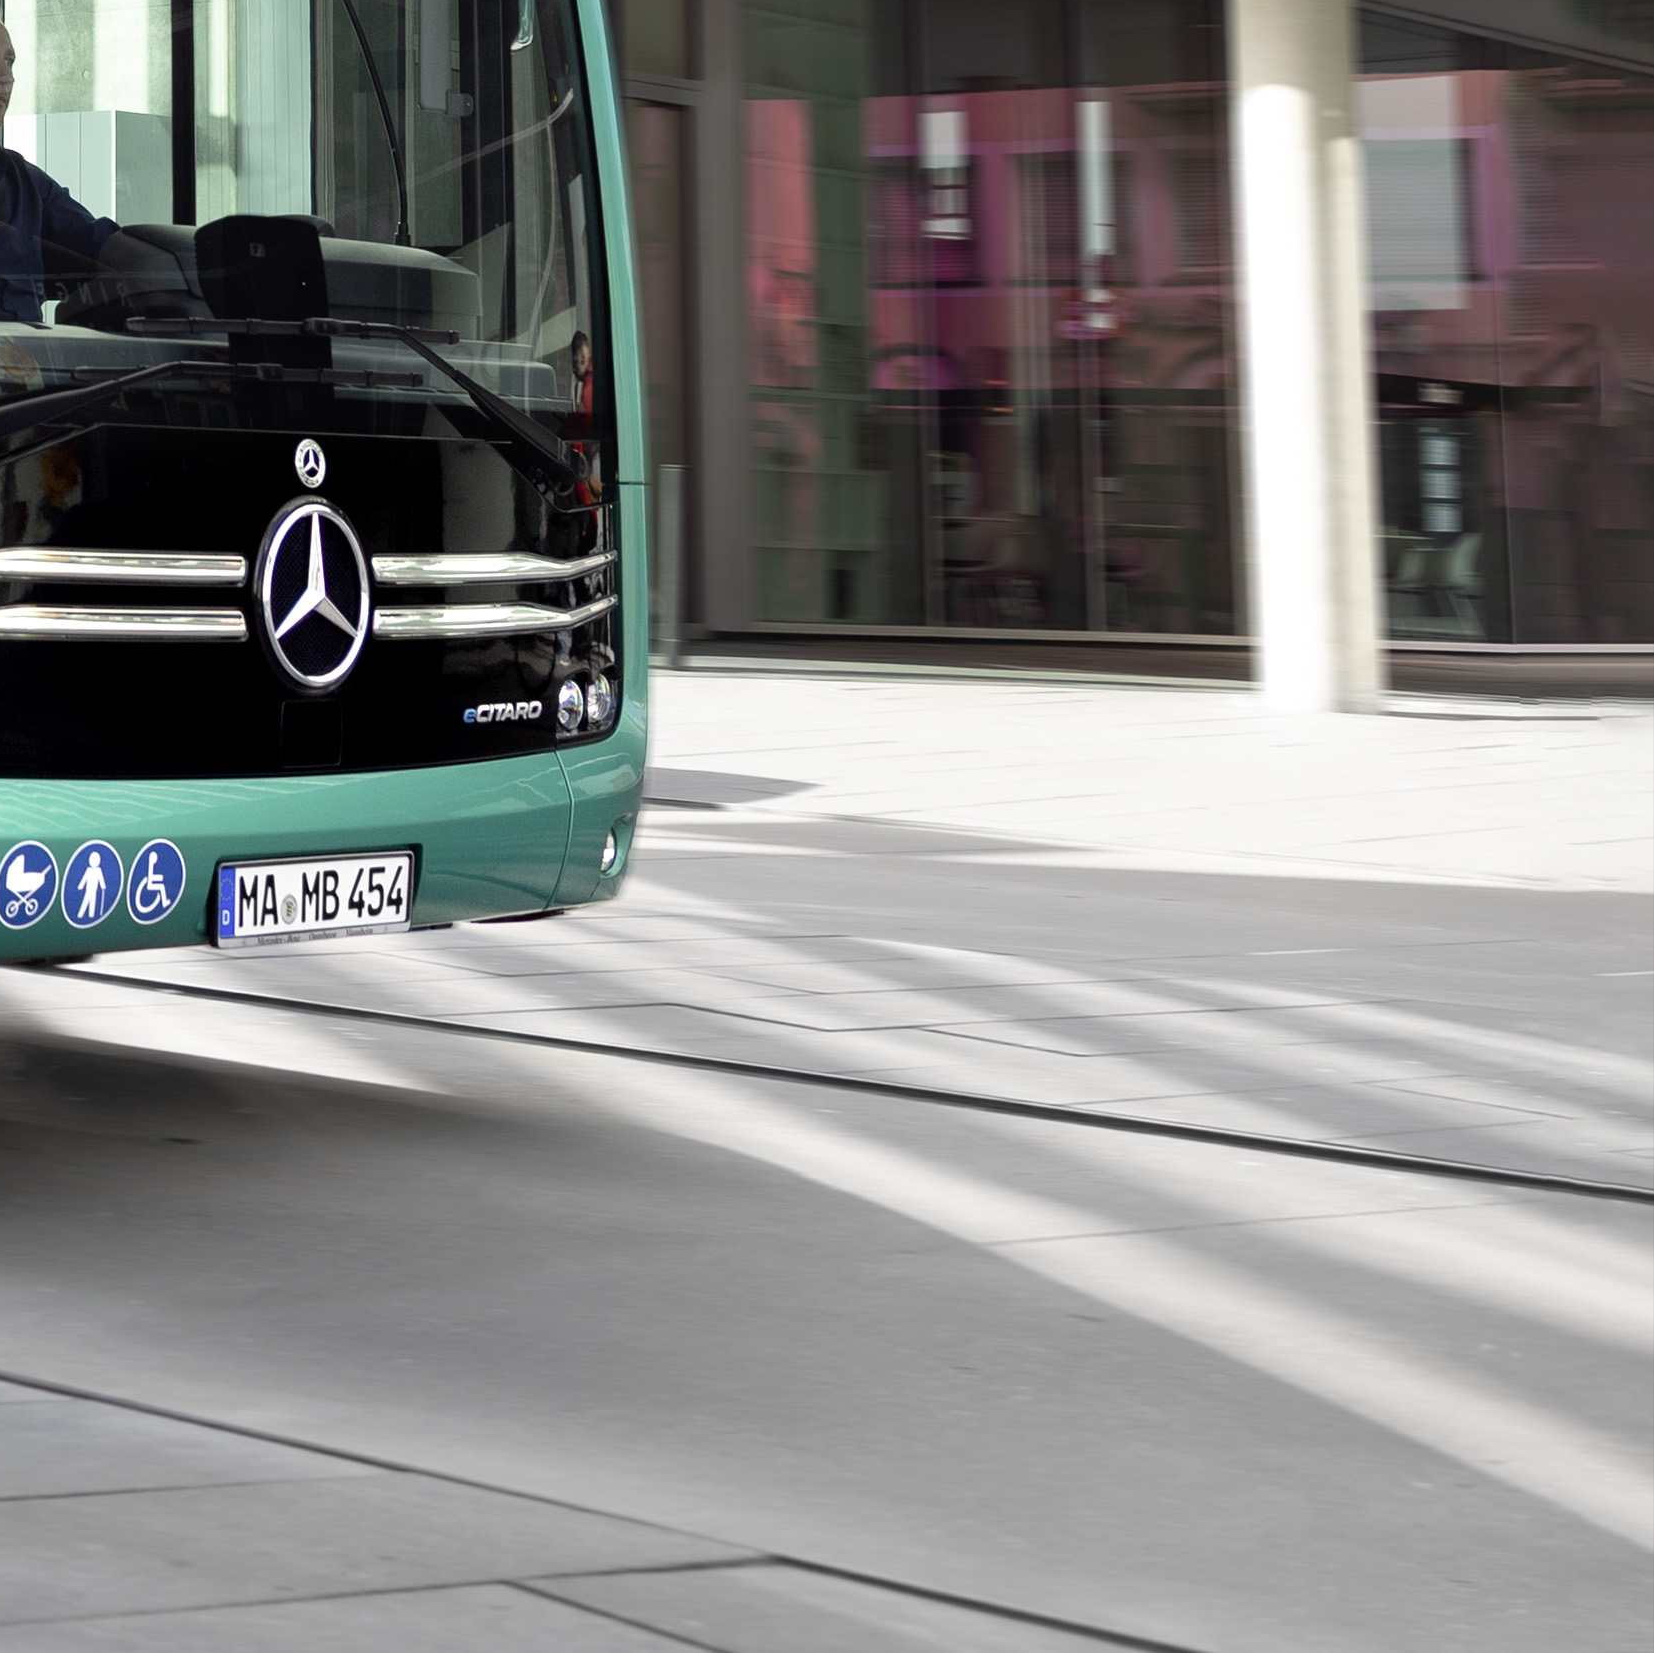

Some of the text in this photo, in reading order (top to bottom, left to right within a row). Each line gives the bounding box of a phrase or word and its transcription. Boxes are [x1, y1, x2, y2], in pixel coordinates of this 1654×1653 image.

[462, 700, 543, 724] eCITARO
[221, 865, 404, 928] D MA MB 454
